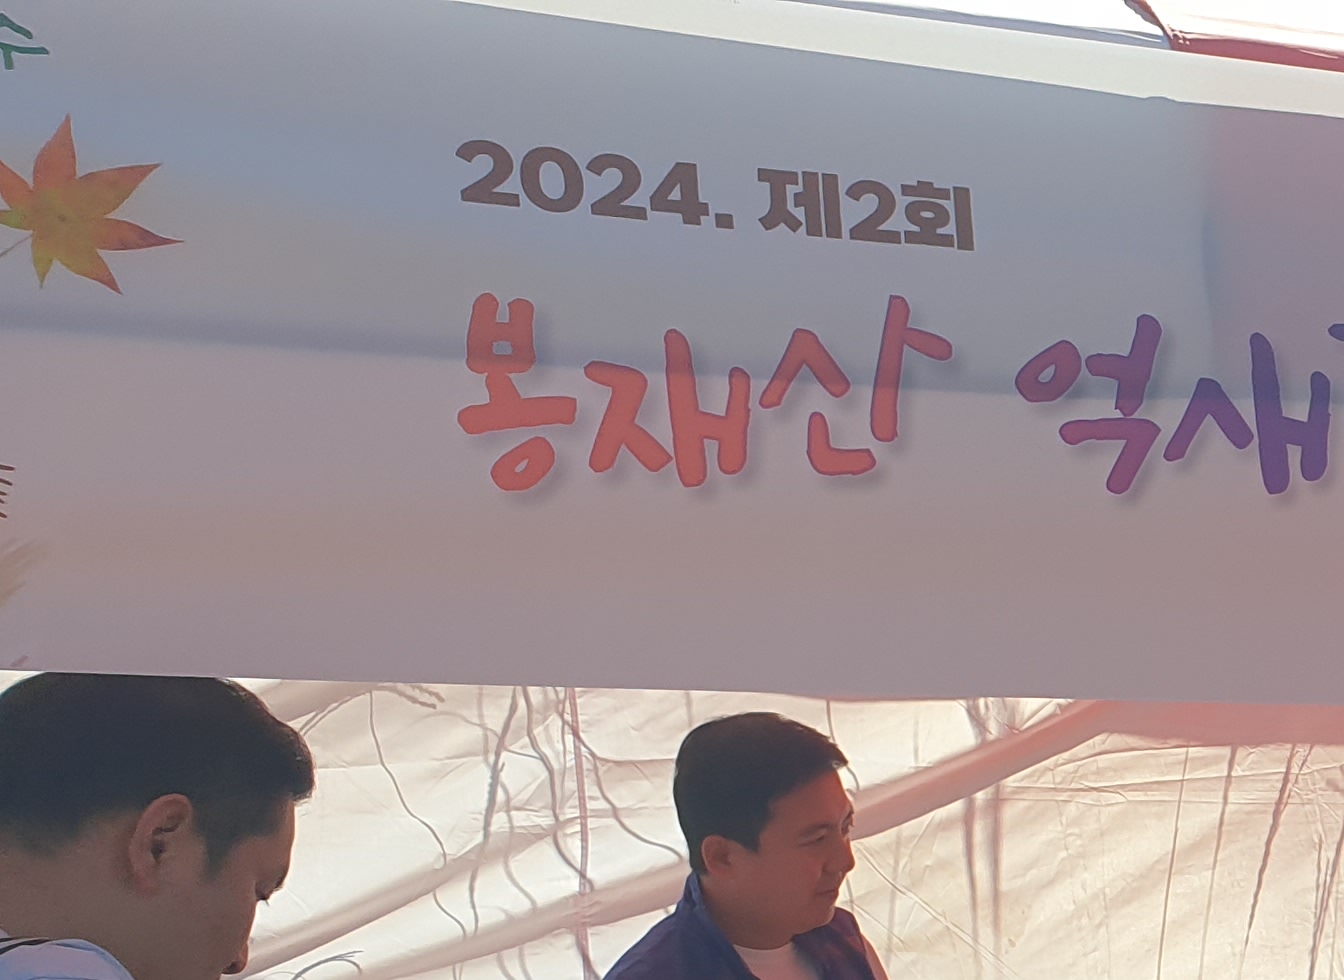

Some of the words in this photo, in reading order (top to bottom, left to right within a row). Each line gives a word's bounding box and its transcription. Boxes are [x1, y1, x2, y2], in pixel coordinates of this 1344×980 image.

[455, 139, 735, 230] 2024.
[757, 166, 976, 252] 제2회
[457, 291, 953, 492] 봉재산
